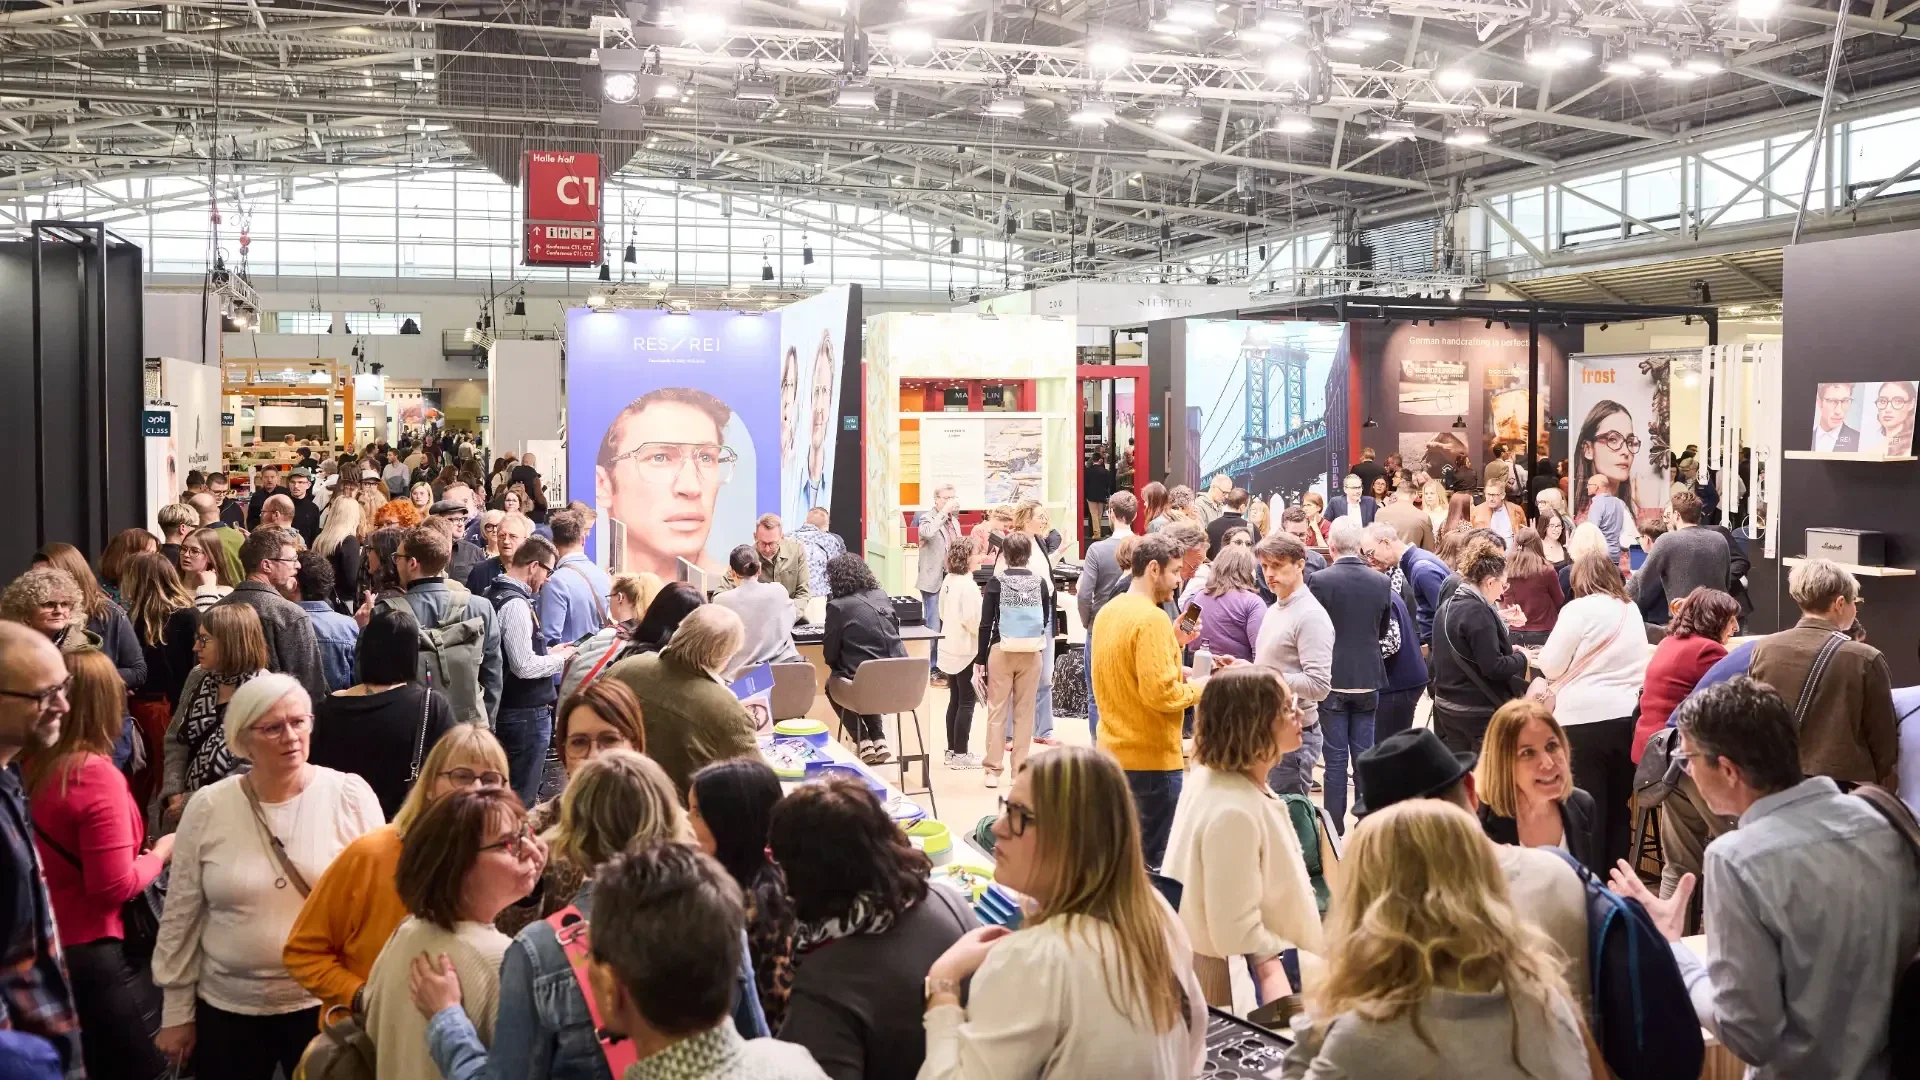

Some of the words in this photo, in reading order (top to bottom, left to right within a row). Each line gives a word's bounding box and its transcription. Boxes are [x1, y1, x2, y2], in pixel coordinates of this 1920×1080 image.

[533, 154, 555, 163] Halle
[556, 175, 596, 206] C1
[1409, 336, 1440, 345] German
[1441, 336, 1490, 347] handcrafting
[1582, 366, 1616, 384] frost
